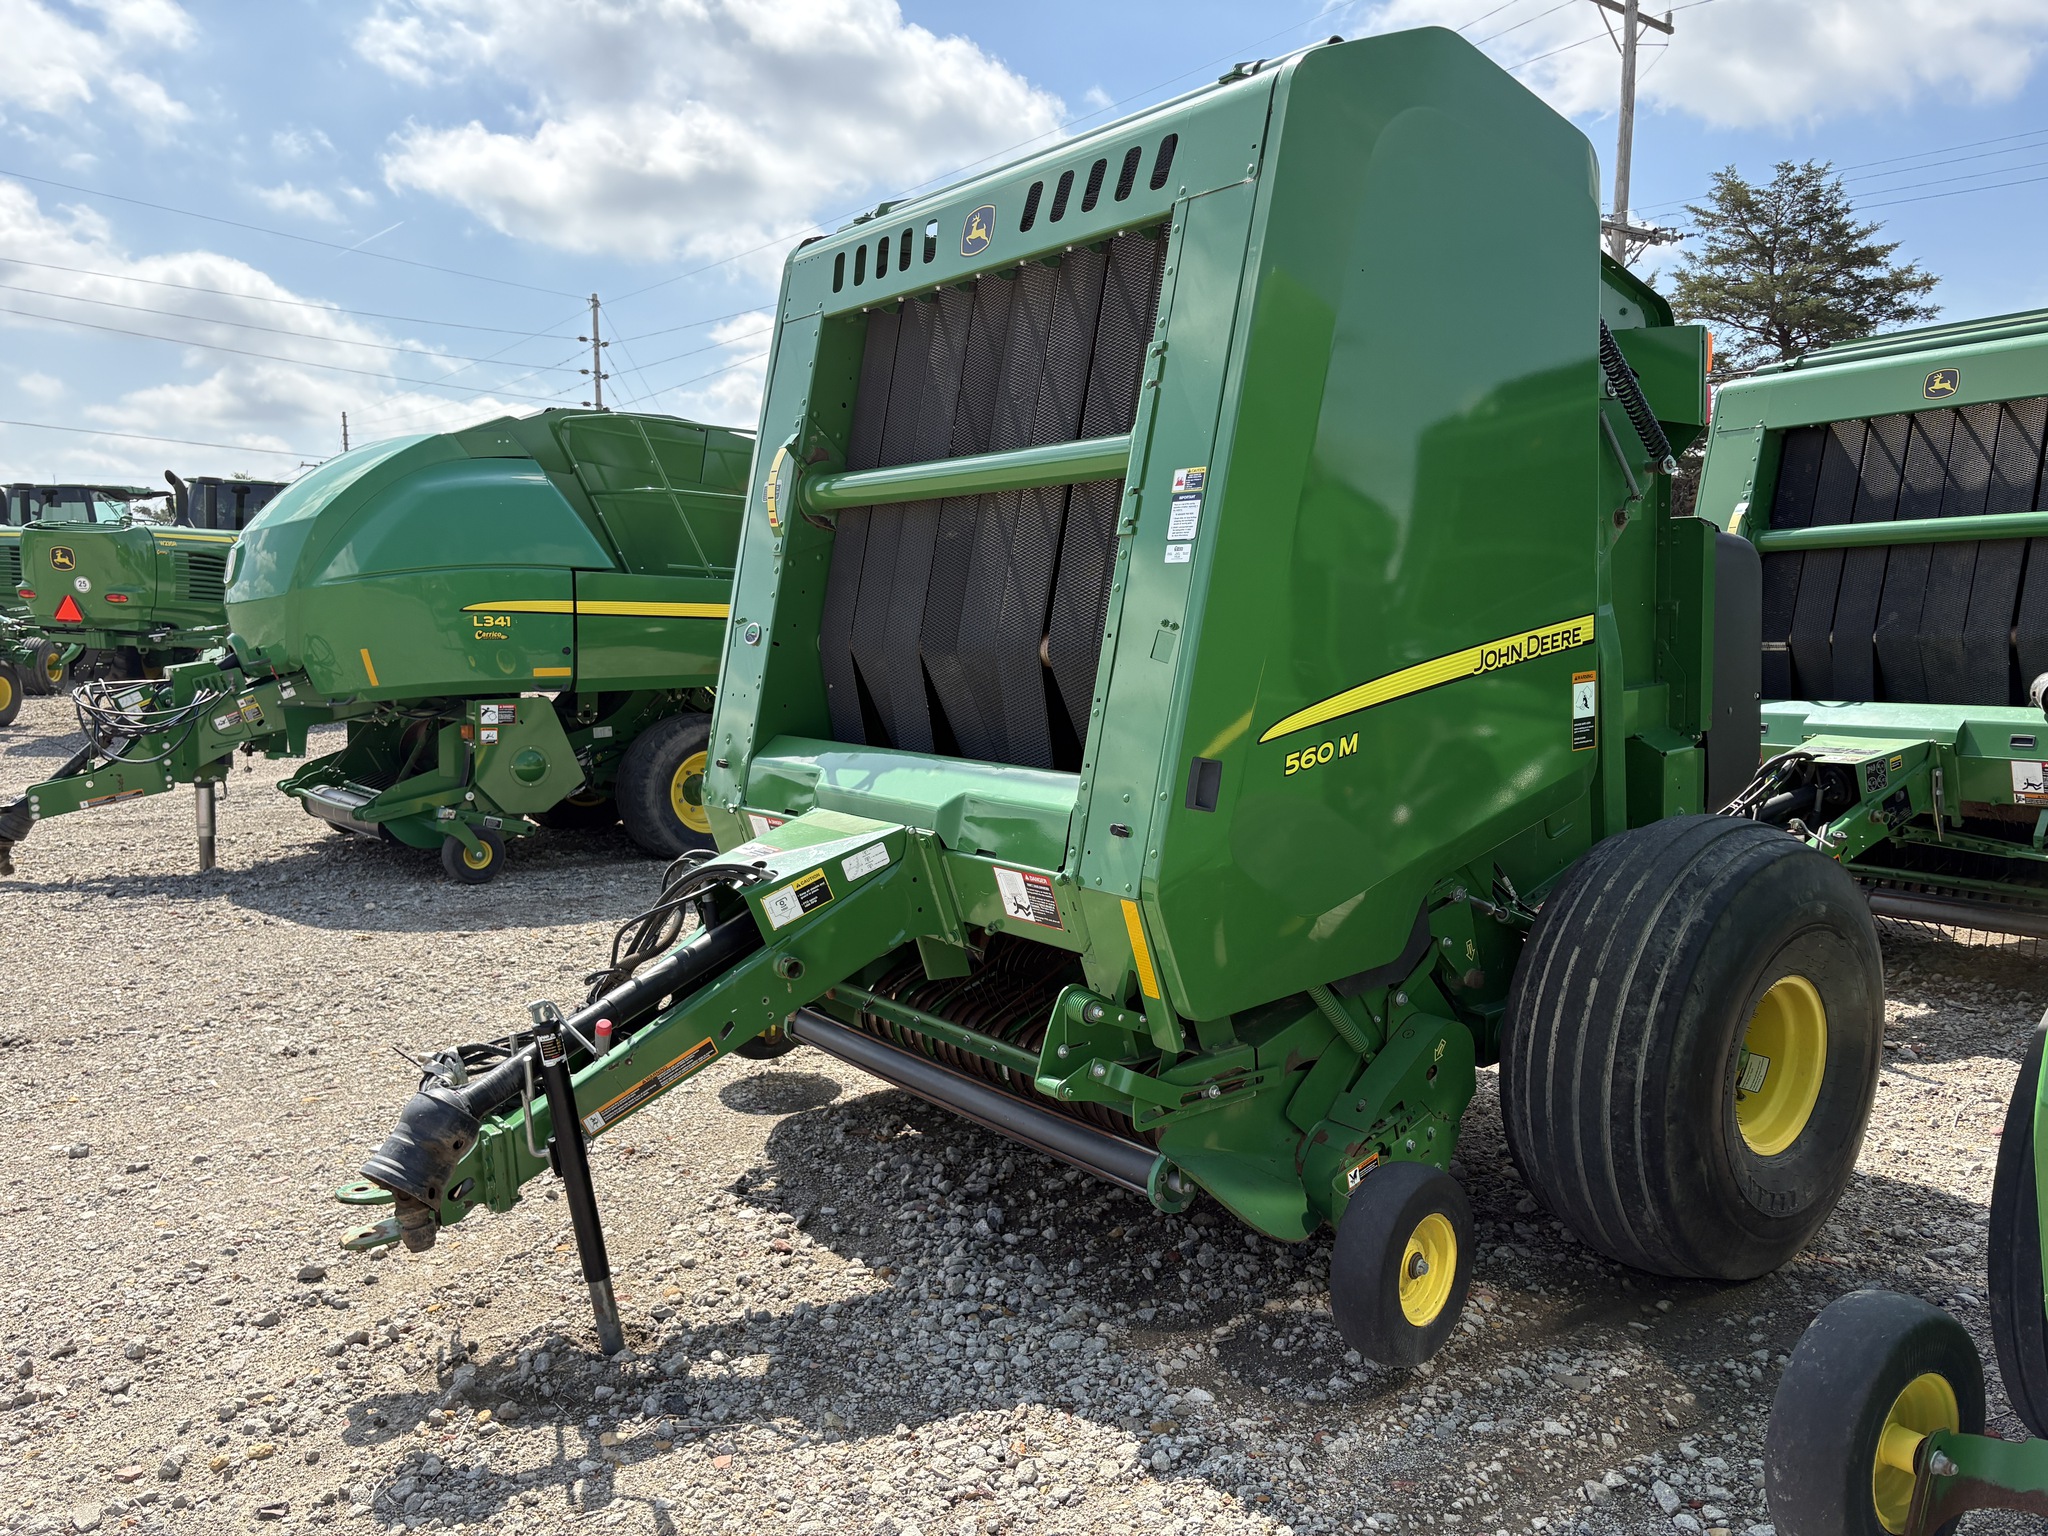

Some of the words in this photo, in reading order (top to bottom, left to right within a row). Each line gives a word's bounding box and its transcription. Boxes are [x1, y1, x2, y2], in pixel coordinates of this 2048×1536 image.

[77, 580, 87, 588] 25
[473, 615, 511, 627] L341
[474, 629, 502, 640] Carrico
[1473, 642, 1523, 673] JOHN
[1526, 626, 1582, 657] DEERE
[1284, 740, 1335, 776] 560
[1338, 731, 1359, 758] M
[800, 872, 821, 886] CAUTION
